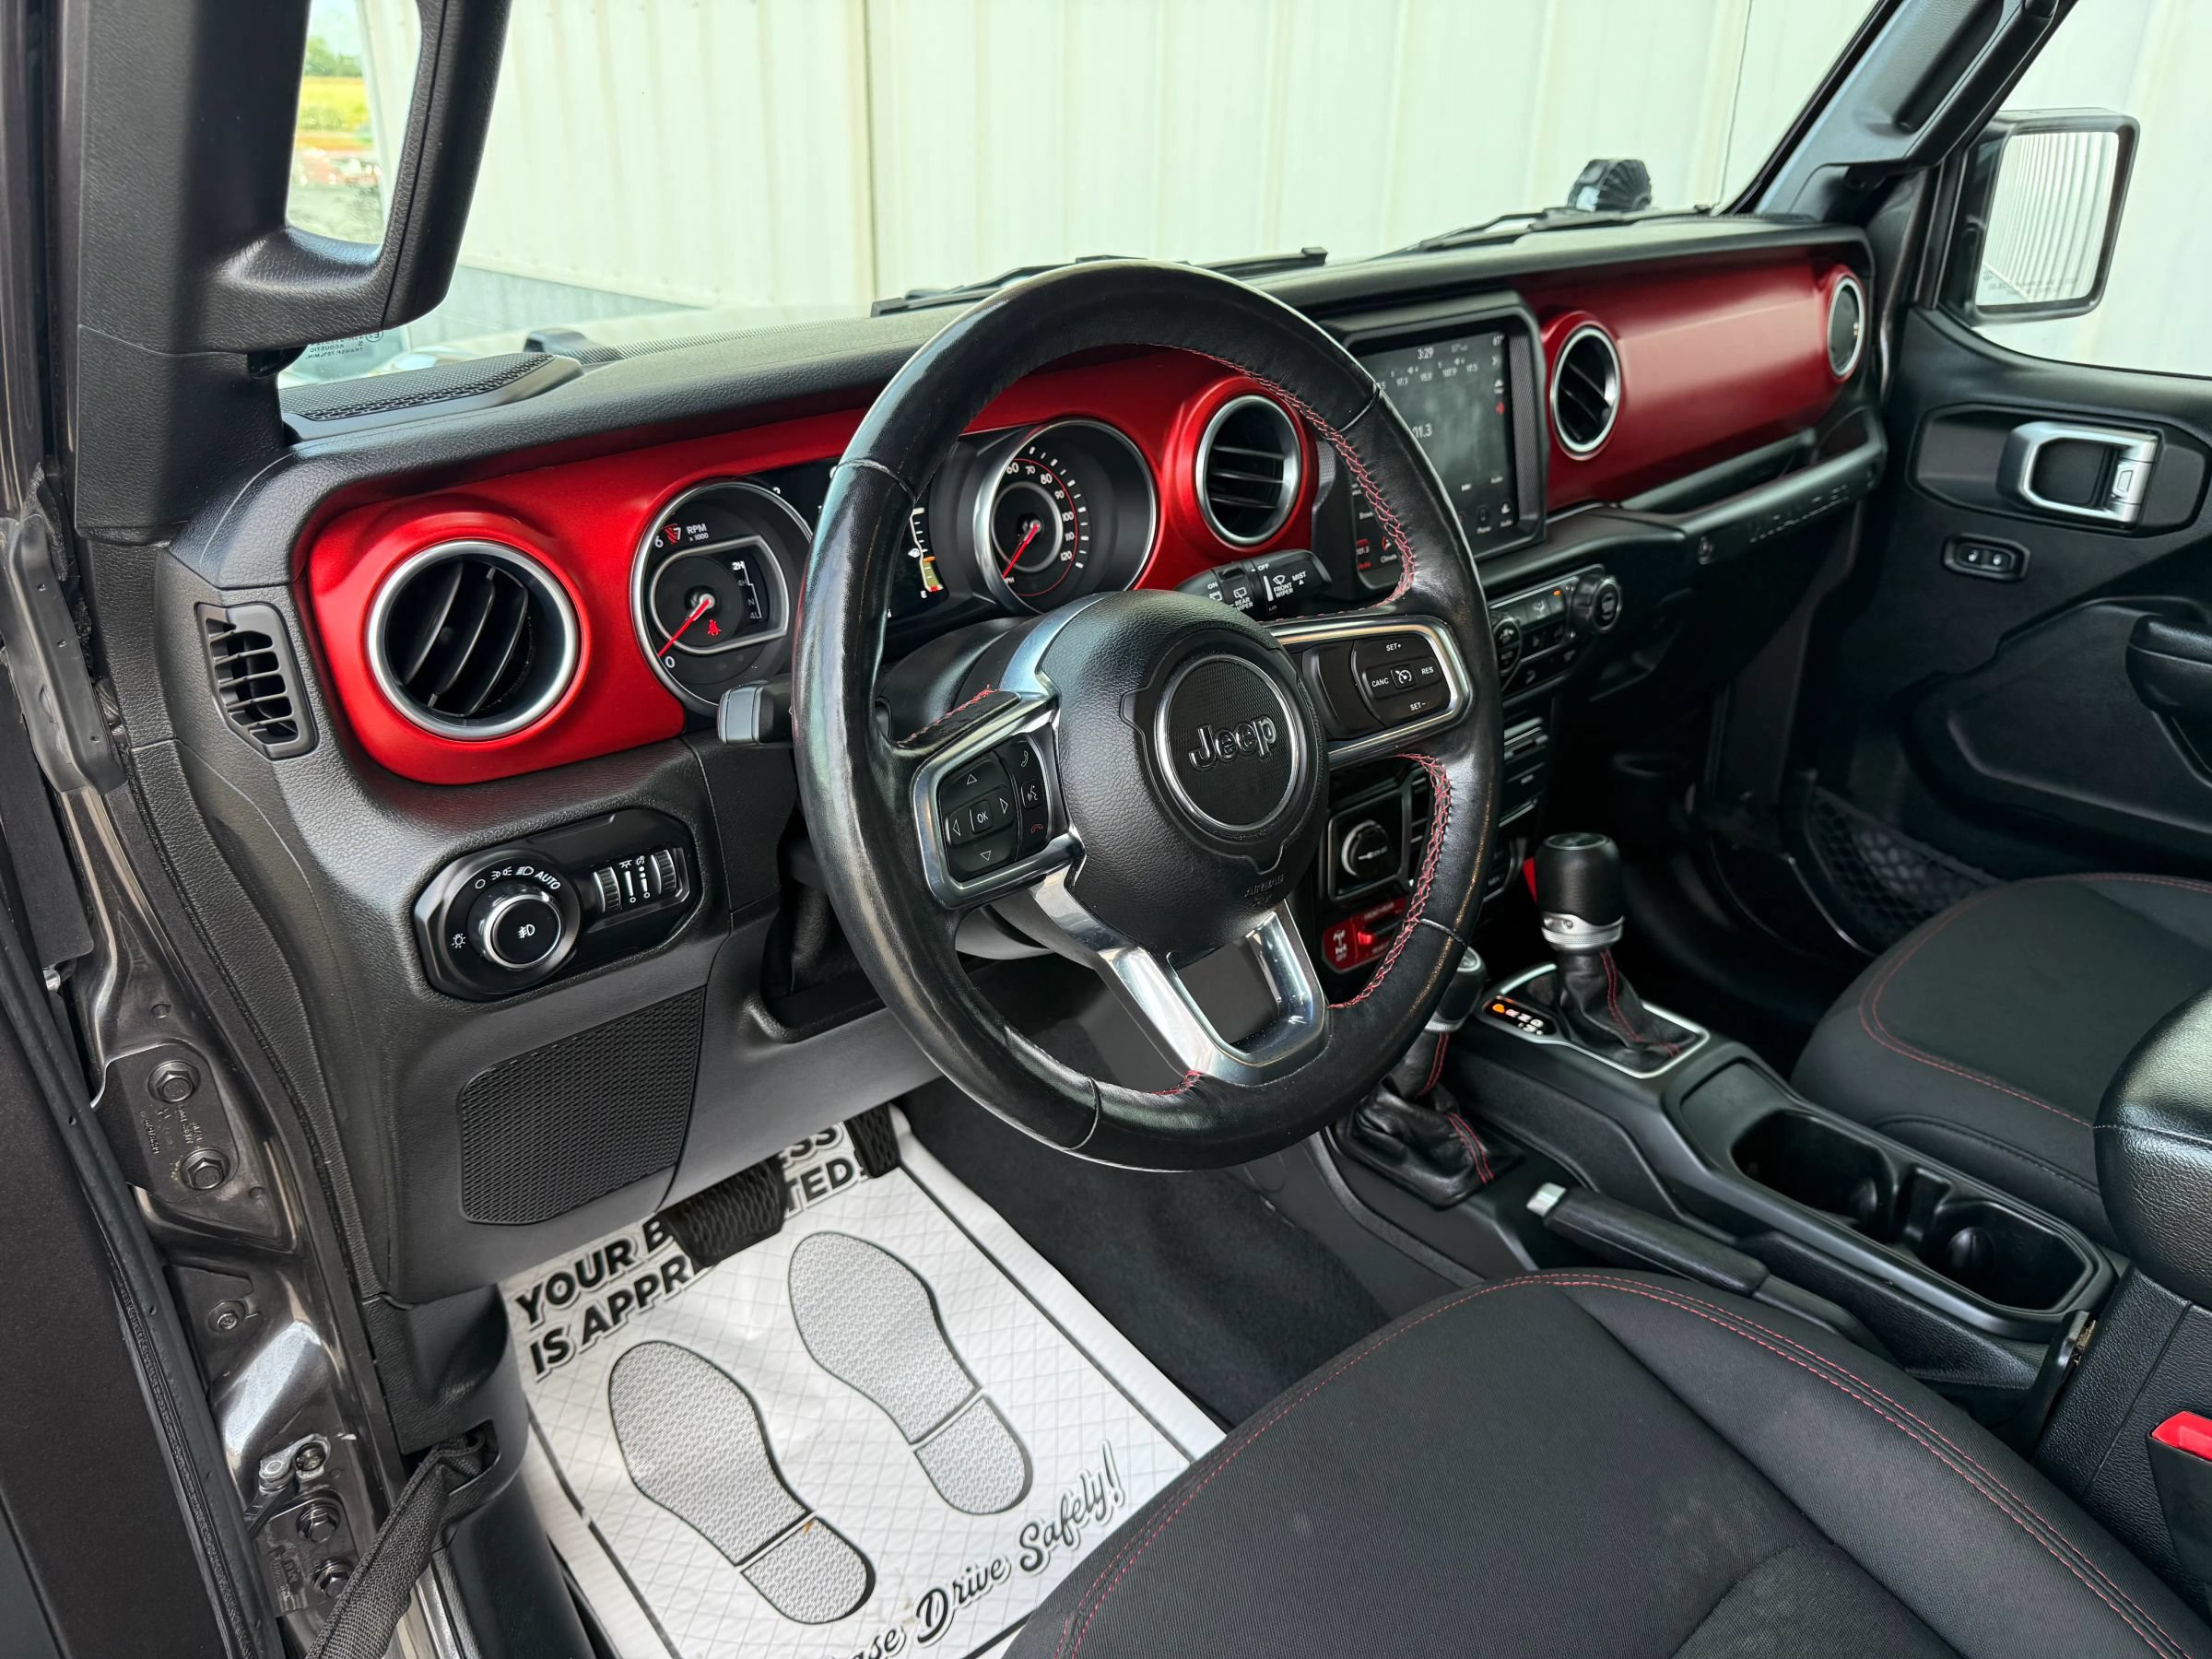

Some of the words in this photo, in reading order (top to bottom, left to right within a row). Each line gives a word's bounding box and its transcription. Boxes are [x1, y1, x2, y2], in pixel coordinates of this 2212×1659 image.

[1025, 465, 1036, 475] 70
[1041, 473, 1053, 485] 80
[1054, 489, 1065, 500] 90
[1062, 512, 1074, 522] 100
[673, 526, 682, 541] 7
[686, 523, 707, 535] RPM
[654, 535, 664, 548] 6
[694, 533, 709, 541] 1000
[732, 560, 745, 571] 2H
[1257, 563, 1270, 571] OFF
[1292, 571, 1307, 582] MIST
[1207, 582, 1218, 590] ON
[1273, 582, 1292, 593] FRONT
[1275, 588, 1294, 598] WIPER
[1235, 597, 1251, 606] REAR
[1421, 666, 1434, 675] RES
[1371, 677, 1389, 688] CANC
[1189, 715, 1277, 771] Jeep
[976, 811, 989, 823] OK
[535, 871, 561, 890] AUTO
[515, 1240, 635, 1325] YOUR
[530, 1328, 571, 1375] IS
[915, 1557, 1006, 1643] Drive
[1019, 1441, 1122, 1571] Safely!
